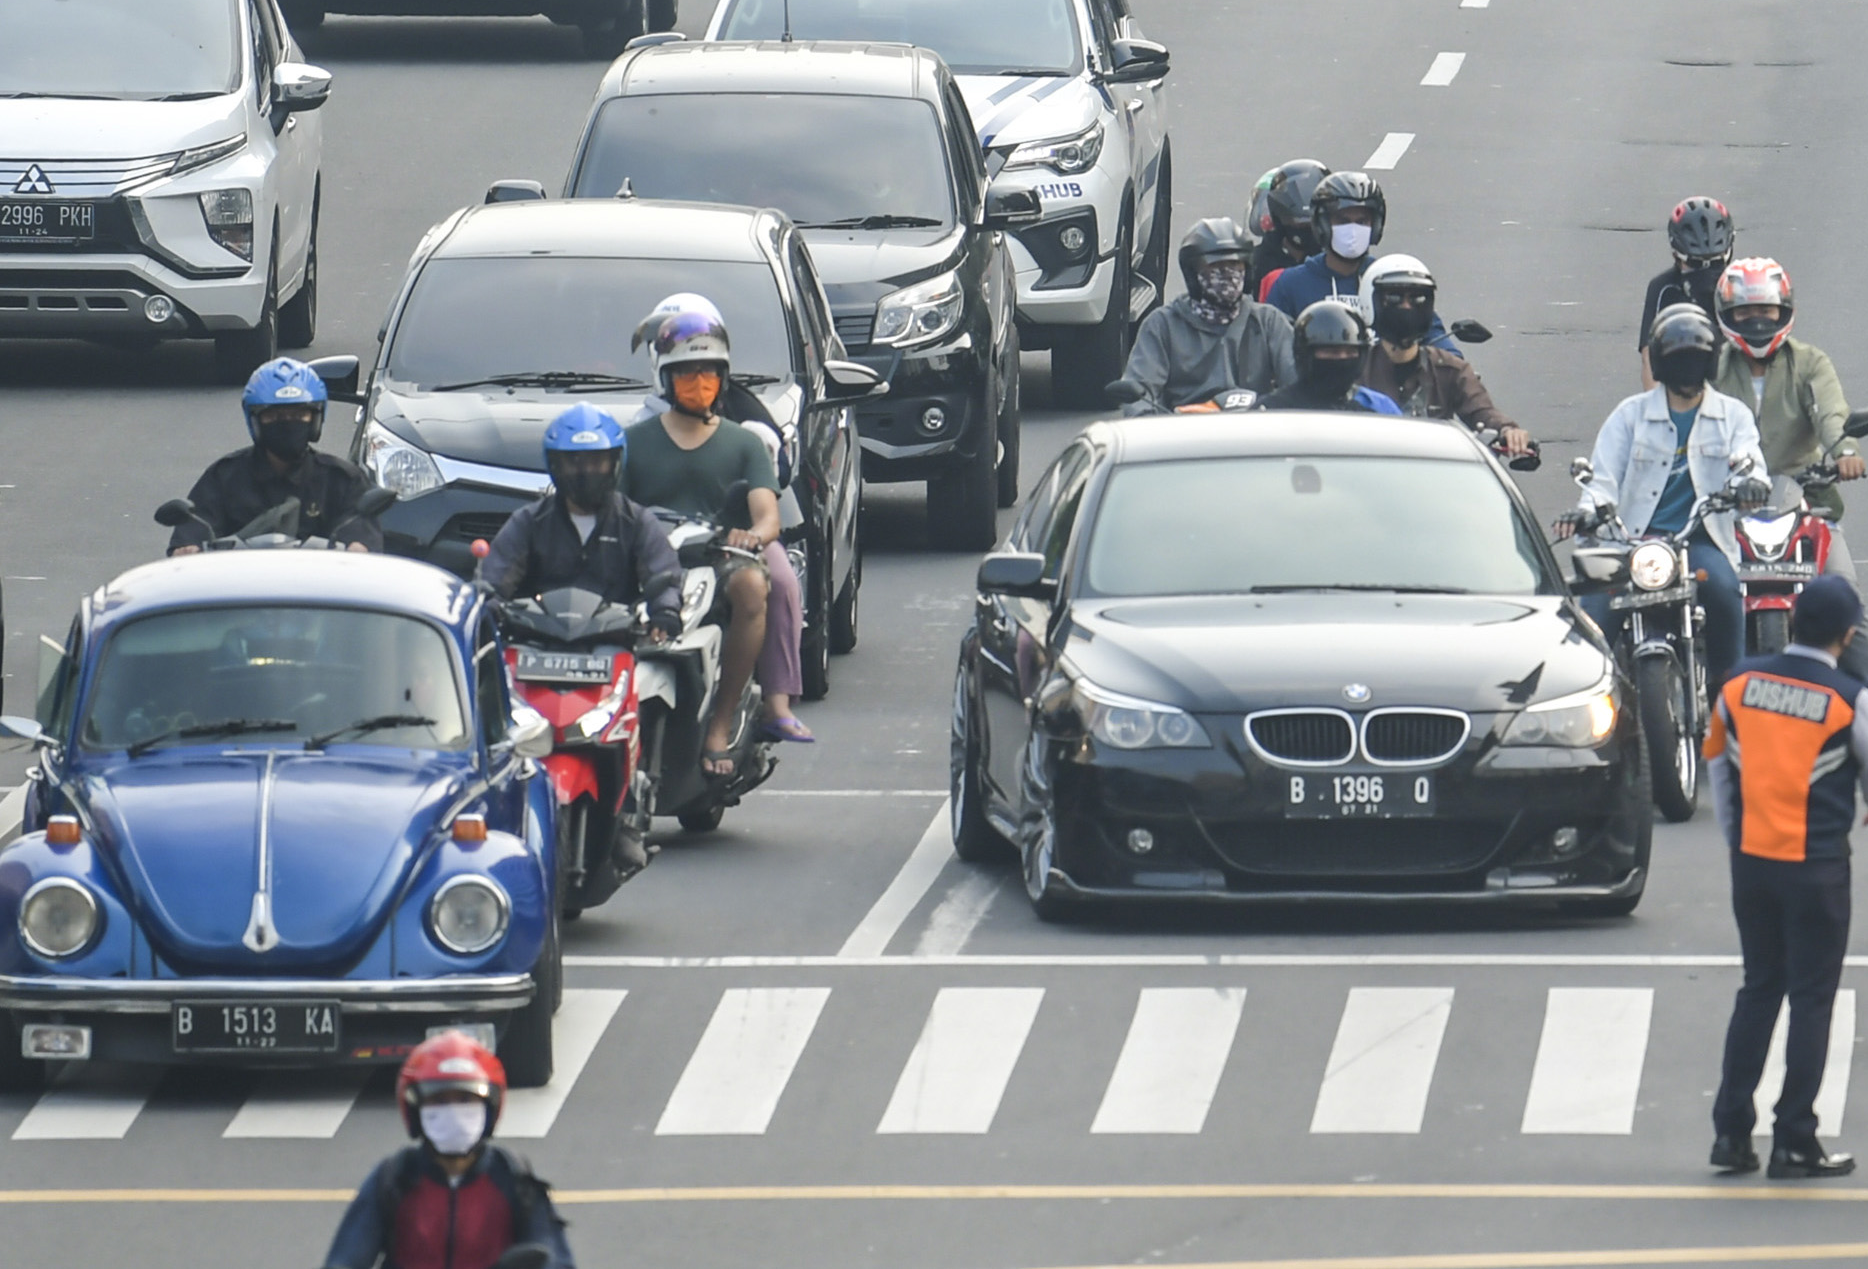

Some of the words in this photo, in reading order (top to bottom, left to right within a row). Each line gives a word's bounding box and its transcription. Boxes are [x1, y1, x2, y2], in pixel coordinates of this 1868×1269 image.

[2, 204, 44, 226] 2996
[60, 205, 93, 227] PKH
[1225, 393, 1253, 409] 93
[1743, 677, 1830, 722] DISHUB
[1290, 776, 1306, 804] B
[1333, 776, 1384, 804] 1396
[178, 1007, 193, 1035] B
[222, 1007, 278, 1035] 1513
[305, 1007, 335, 1035] KA
